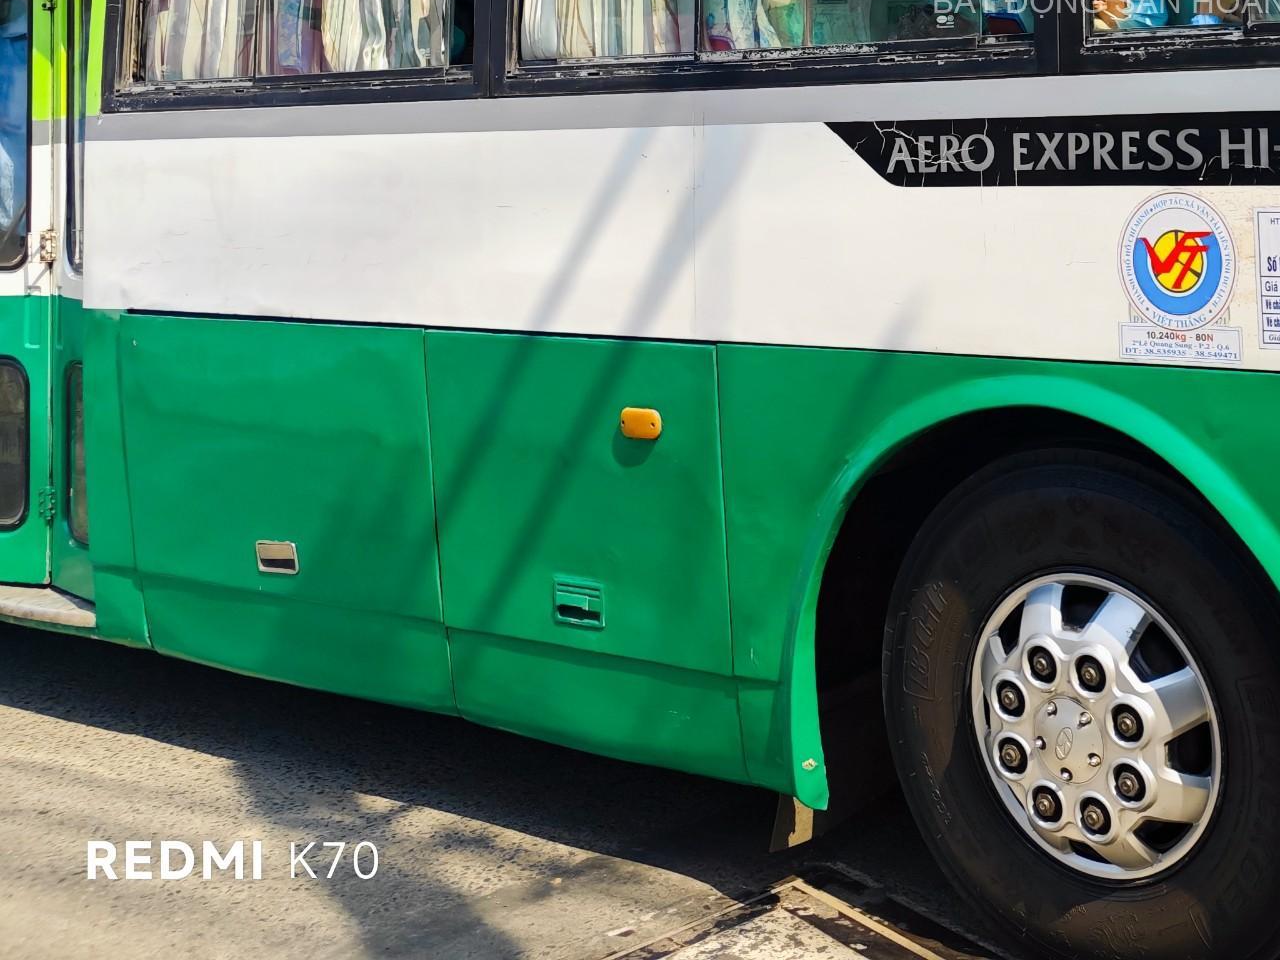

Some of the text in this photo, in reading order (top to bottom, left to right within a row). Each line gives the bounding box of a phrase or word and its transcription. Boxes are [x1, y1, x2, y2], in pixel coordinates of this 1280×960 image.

[886, 134, 995, 174] AERO
[1012, 128, 1203, 172] EXPRESS
[1267, 255, 1278, 272] Số
[1265, 282, 1279, 293] Giá
[1146, 331, 1187, 342] 10.240kg
[1195, 333, 1214, 342] 80N
